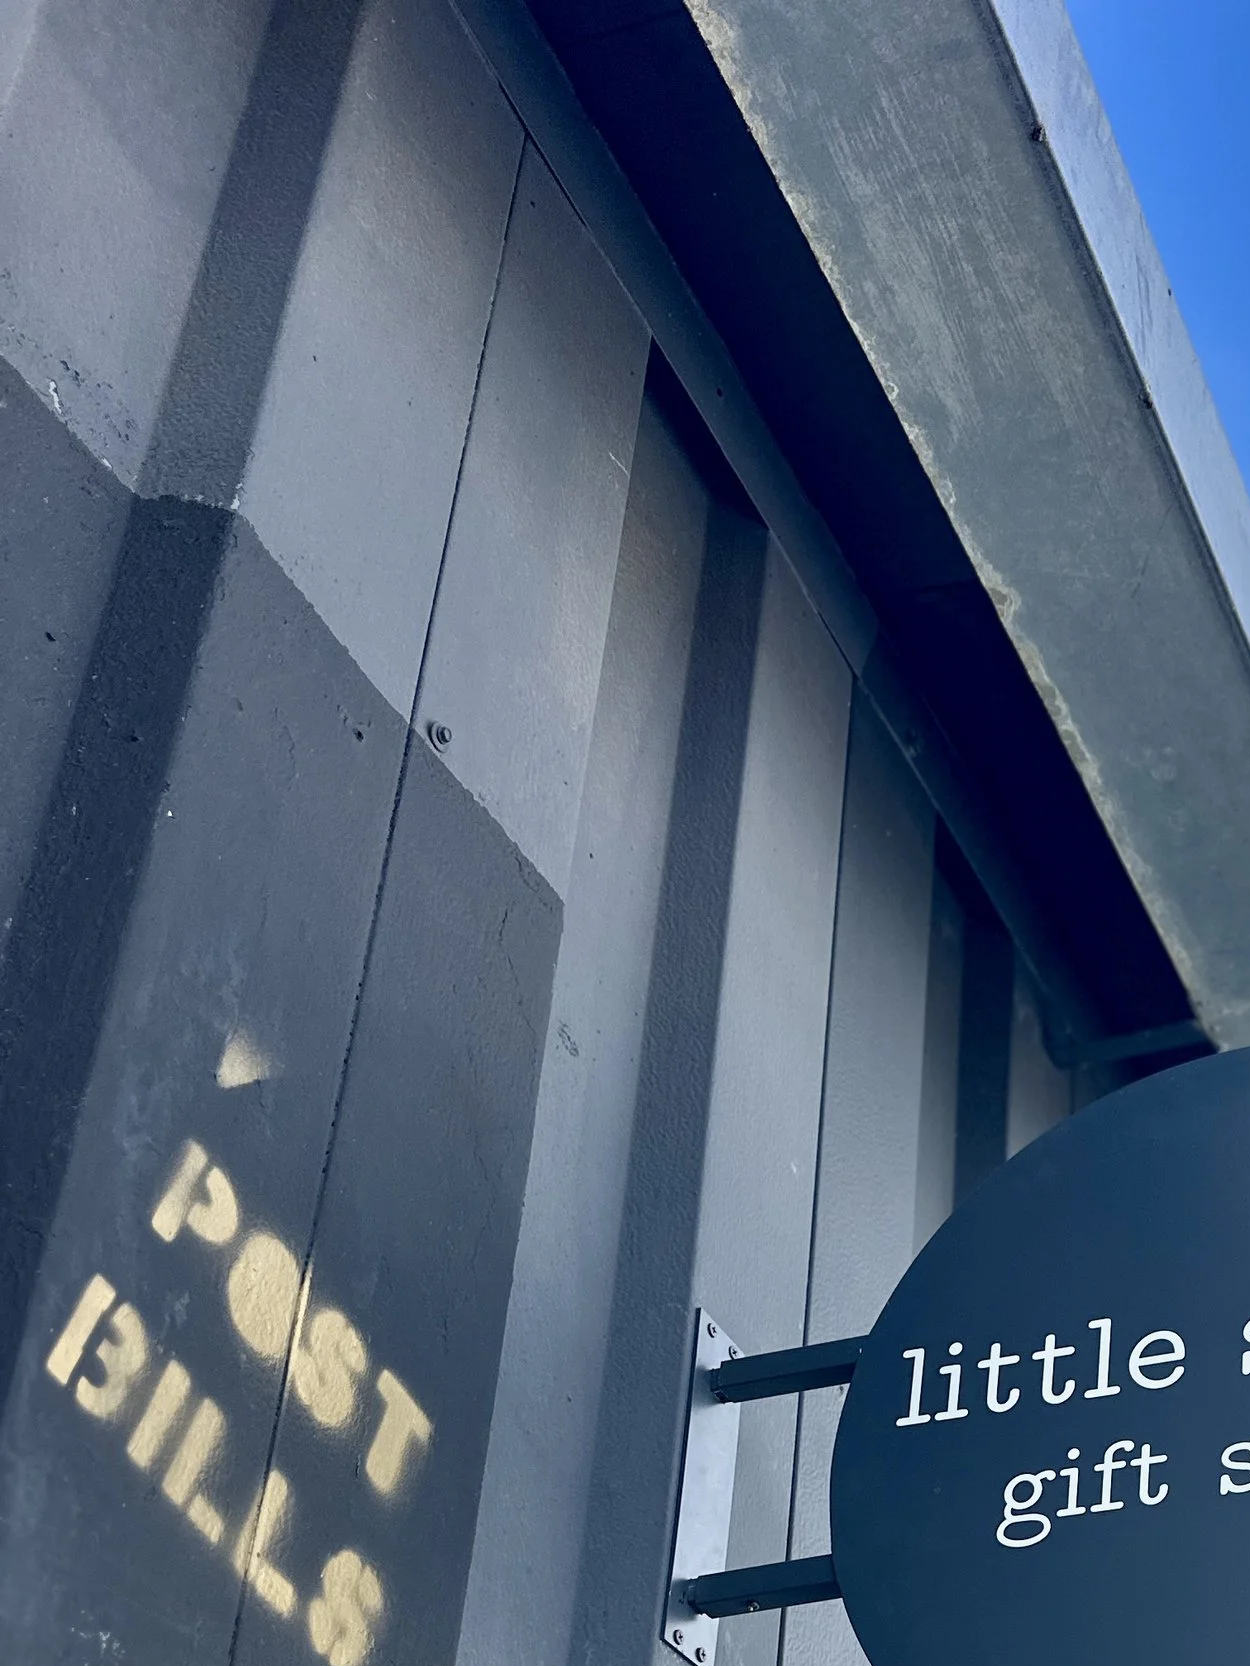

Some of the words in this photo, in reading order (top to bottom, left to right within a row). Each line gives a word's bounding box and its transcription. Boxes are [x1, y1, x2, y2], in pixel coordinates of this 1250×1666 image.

[150, 1138, 433, 1497] POST
[896, 1318, 1186, 1427] little
[996, 1440, 1169, 1548] gift
